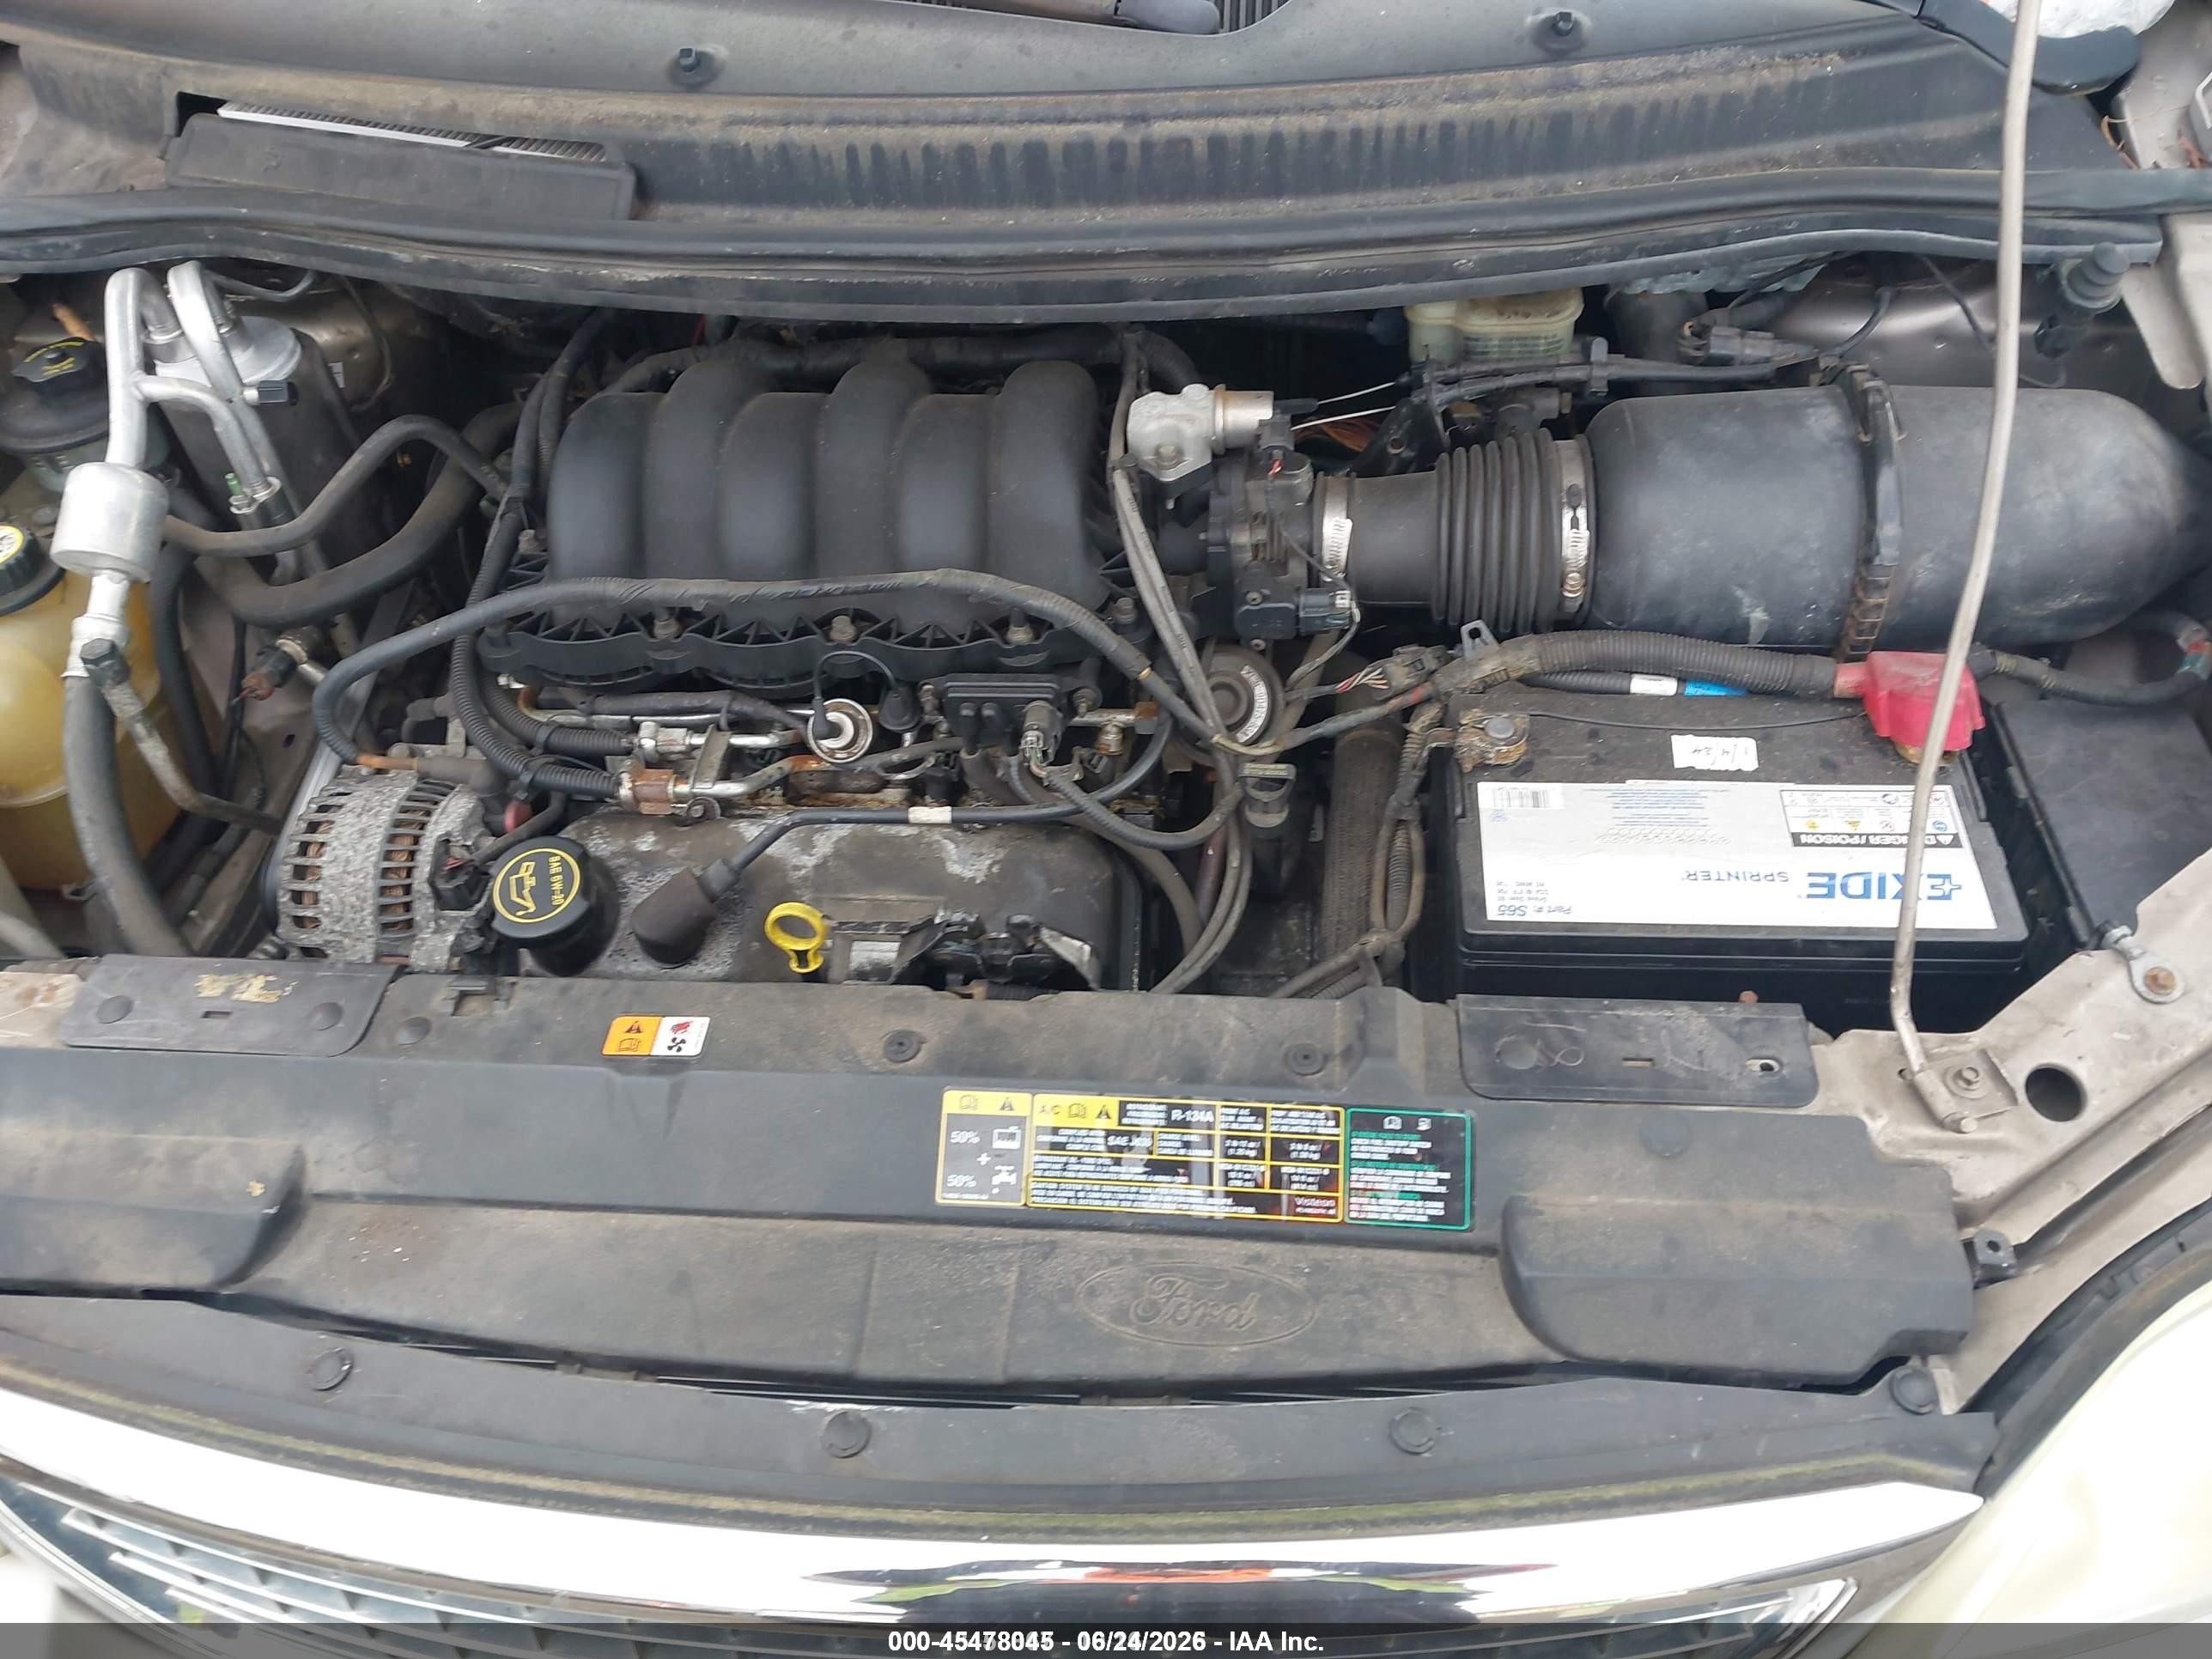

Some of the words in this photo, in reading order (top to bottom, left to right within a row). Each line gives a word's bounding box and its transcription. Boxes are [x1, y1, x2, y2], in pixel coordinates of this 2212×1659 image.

[1685, 870, 1790, 883] SPRINTER
[1498, 904, 1528, 916] S65
[950, 1130, 981, 1144] 50%
[946, 1174, 977, 1188] 50%
[1130, 1273, 1259, 1330] Ford
